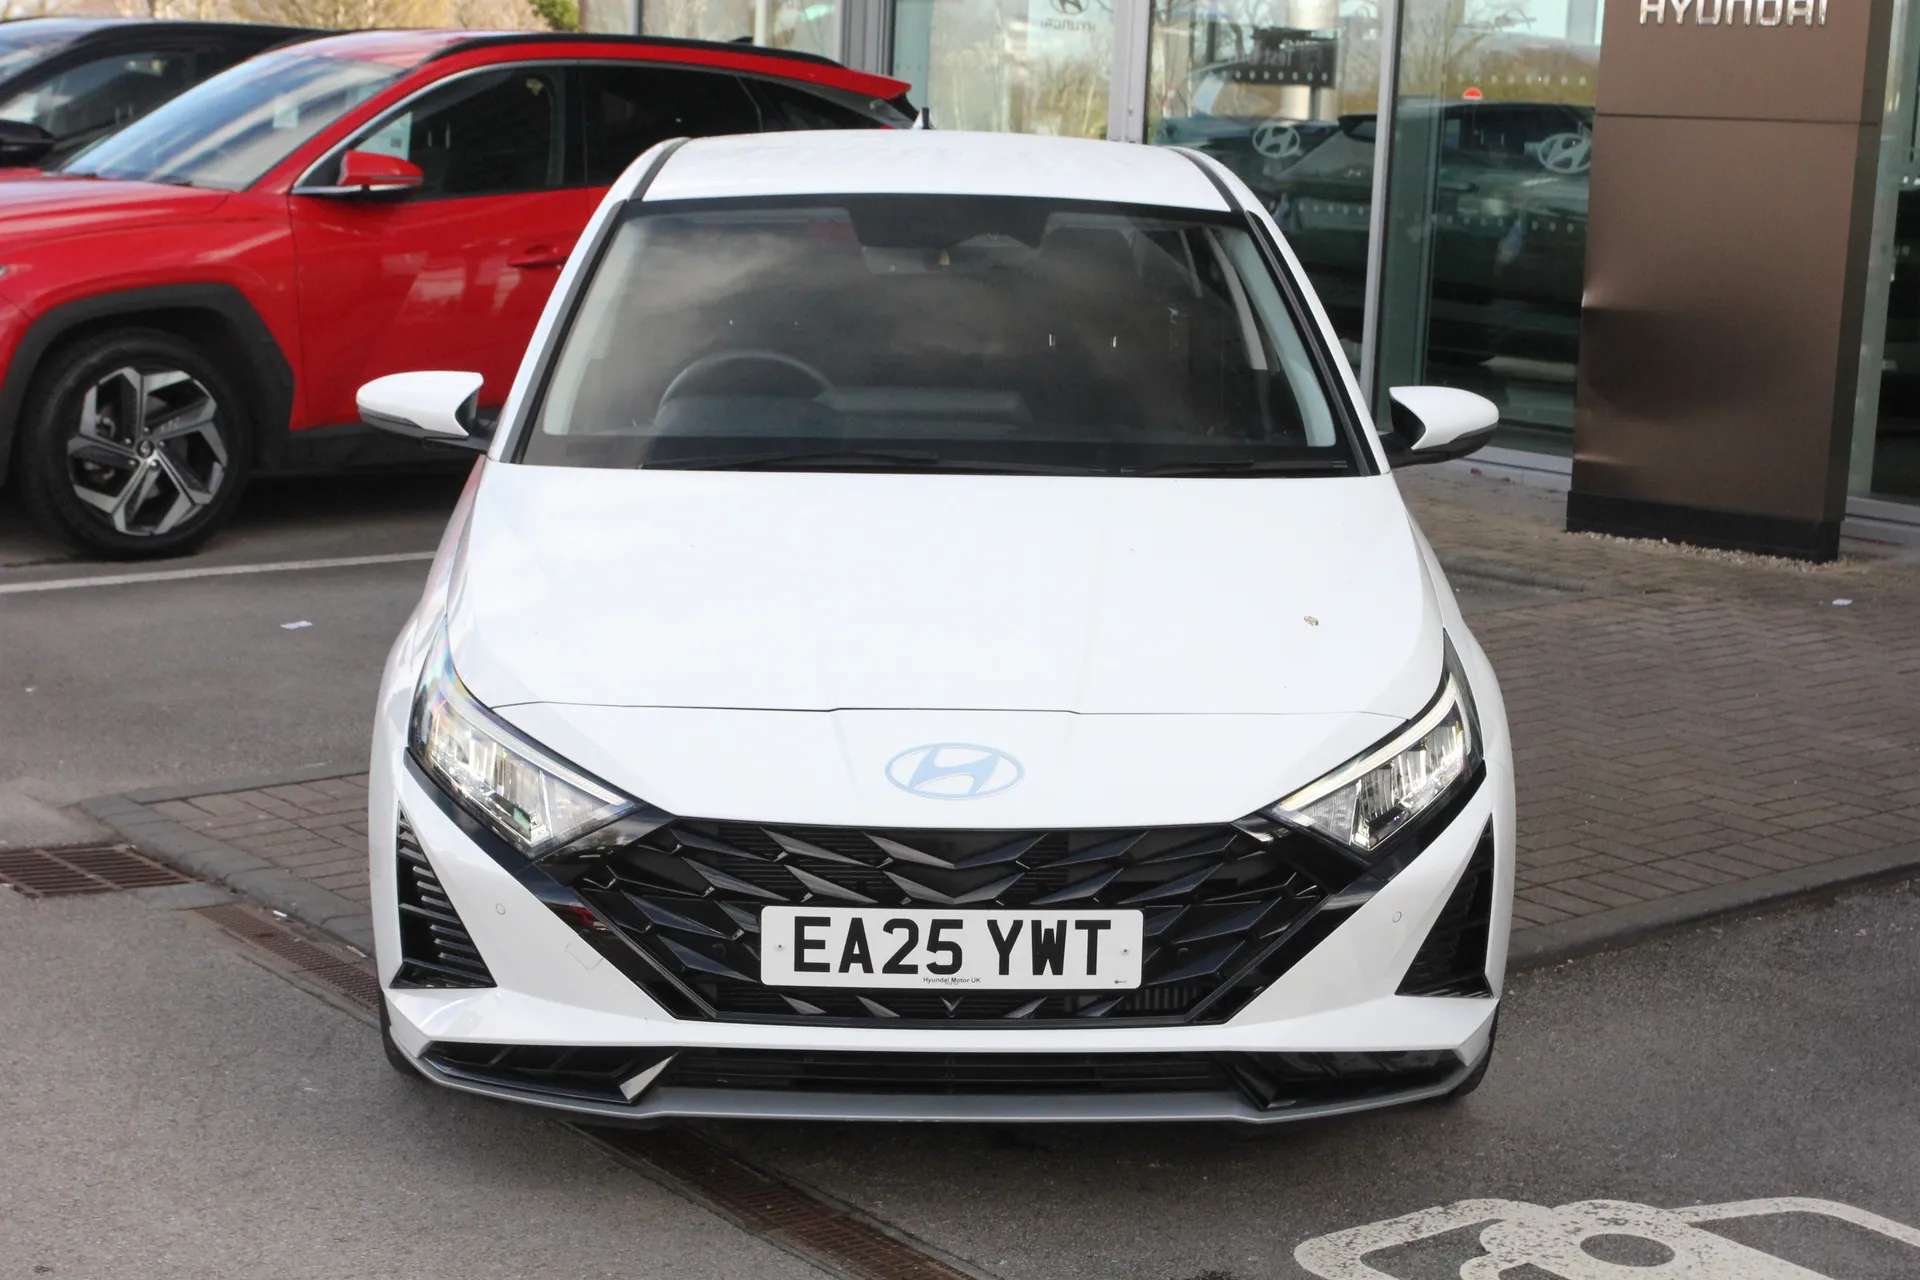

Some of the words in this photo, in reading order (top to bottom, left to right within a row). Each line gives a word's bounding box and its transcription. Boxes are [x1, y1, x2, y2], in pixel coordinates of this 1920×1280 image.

[1638, 0, 1829, 26] HYUNDAI
[794, 916, 963, 975] EA25
[987, 919, 1112, 976] YWT
